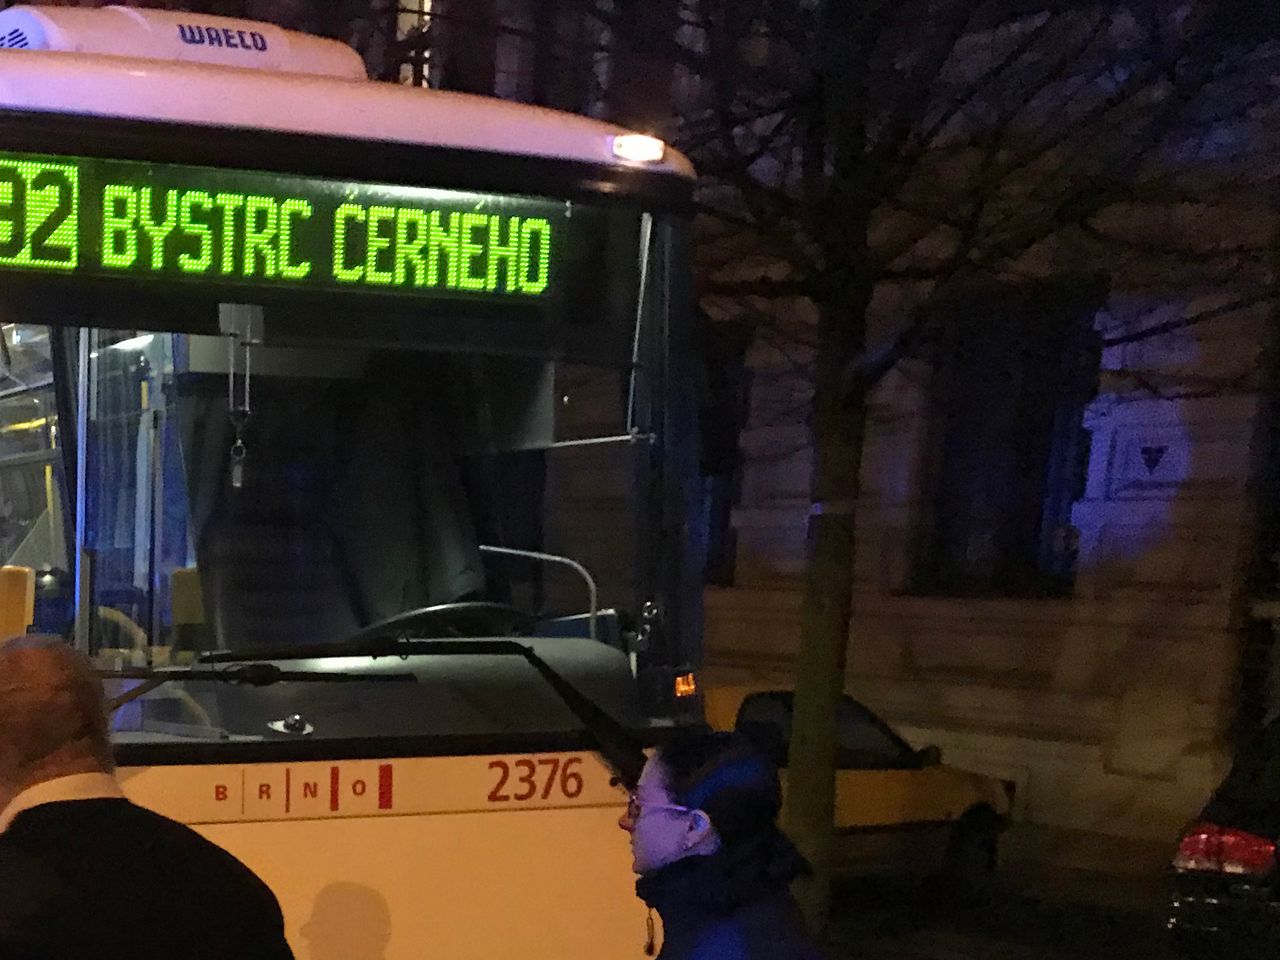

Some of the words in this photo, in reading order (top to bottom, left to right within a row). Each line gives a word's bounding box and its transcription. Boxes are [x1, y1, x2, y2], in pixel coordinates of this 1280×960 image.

[177, 23, 268, 52] WAECO
[101, 184, 312, 280] BYSTRC
[487, 757, 583, 802] 2376
